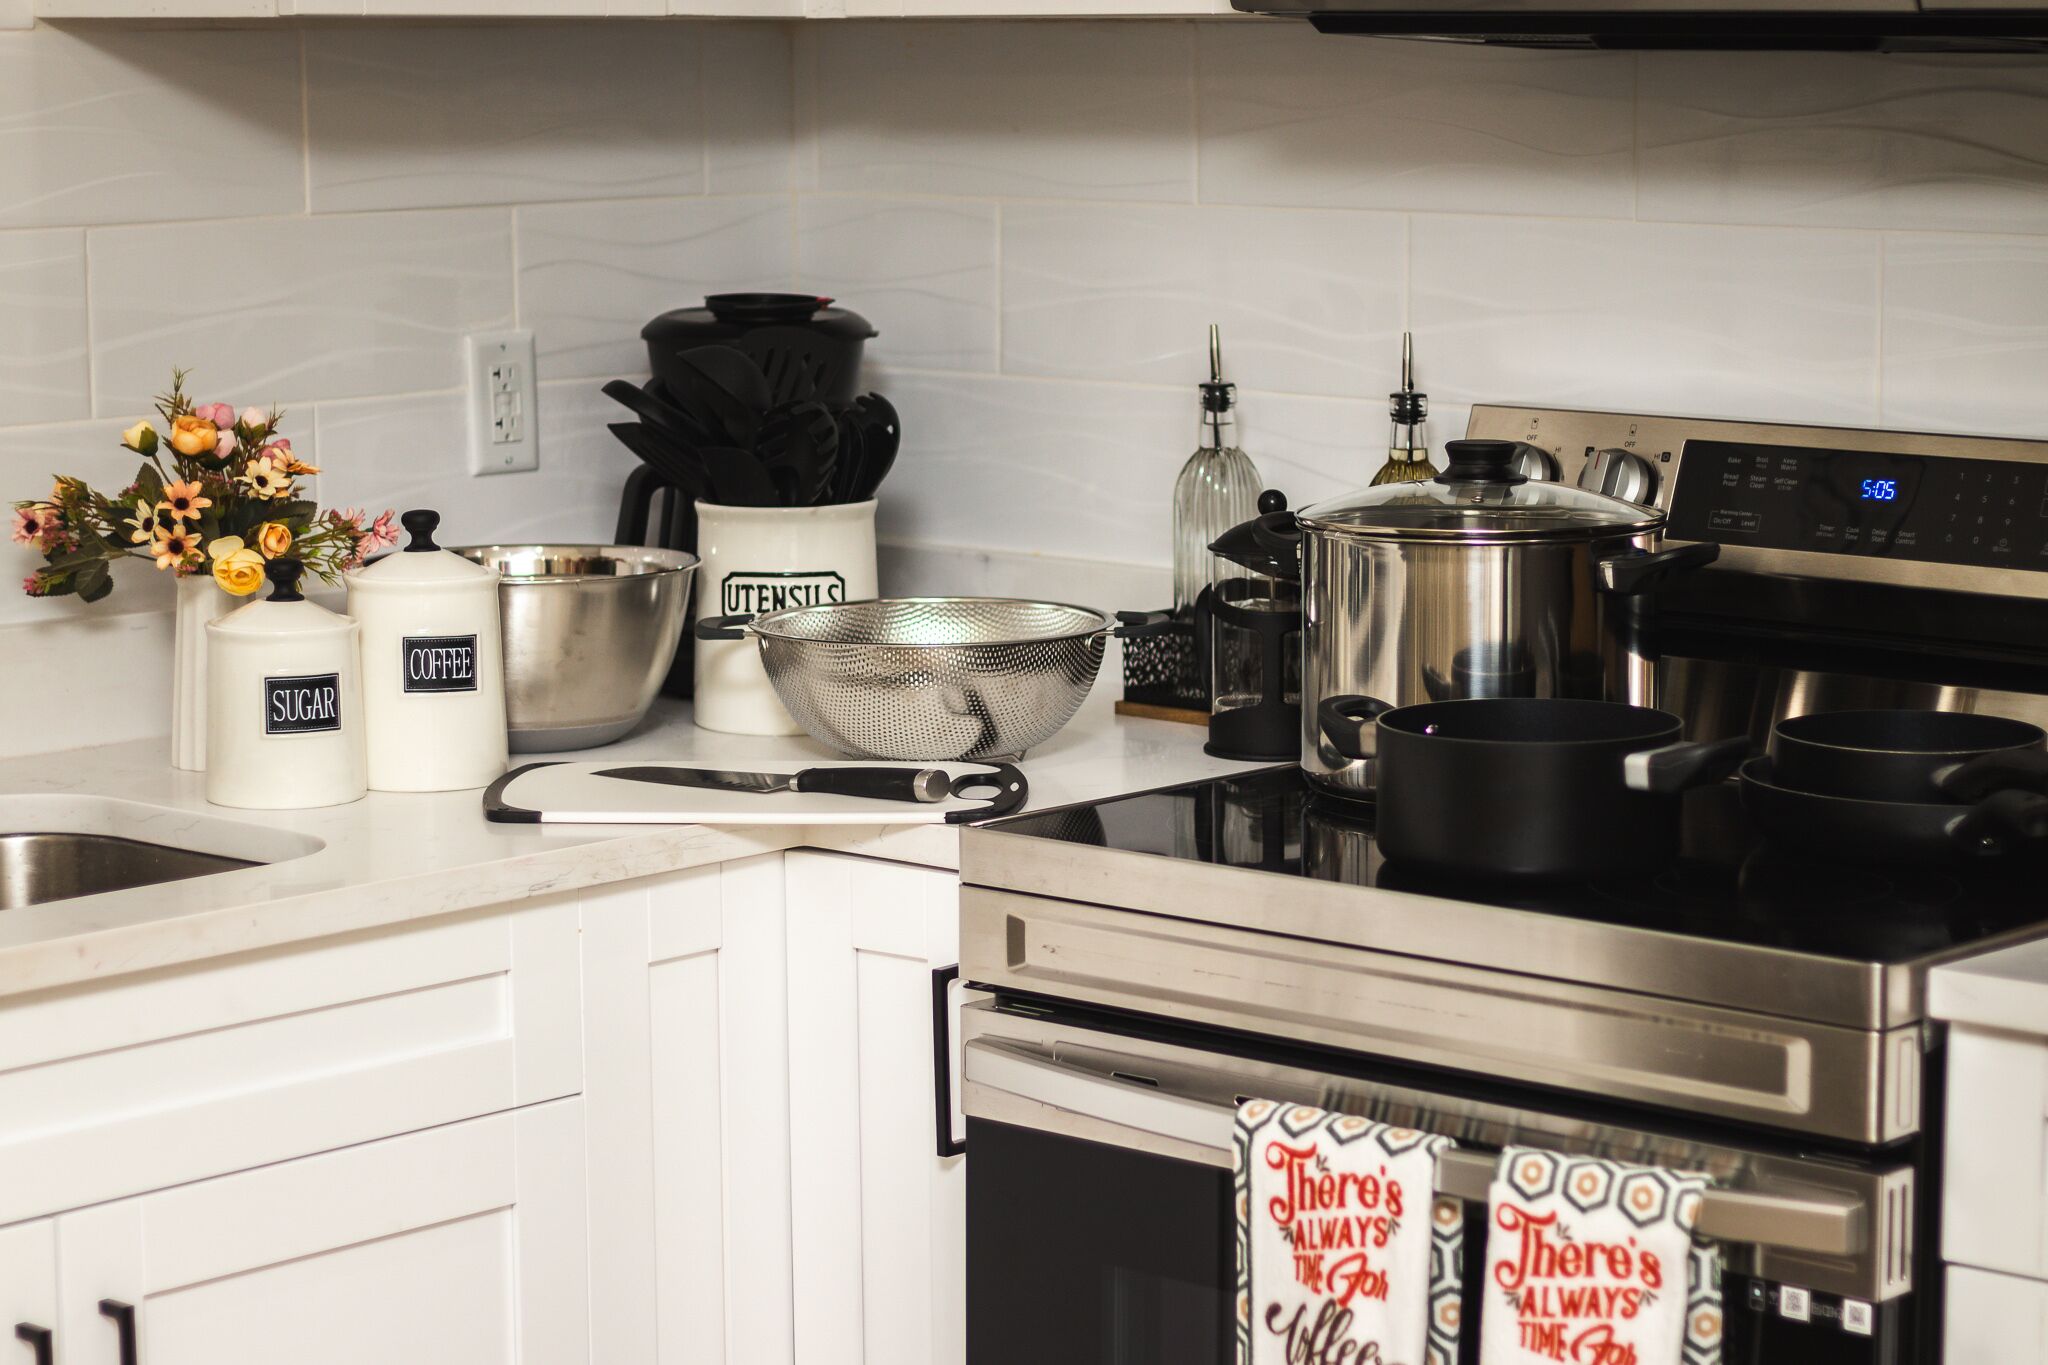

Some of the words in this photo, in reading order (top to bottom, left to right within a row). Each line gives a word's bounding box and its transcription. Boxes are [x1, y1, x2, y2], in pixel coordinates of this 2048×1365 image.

[1861, 479, 1896, 499] 5:05
[727, 583, 840, 613] UTENSILS
[410, 647, 472, 680] COFFEE
[272, 687, 336, 722] SUGAR
[1265, 1141, 1403, 1226] There's
[1293, 1216, 1389, 1251] ALWAYS
[1494, 1202, 1663, 1290] There's
[1292, 1253, 1325, 1295] TIME
[1326, 1251, 1389, 1308] For
[1519, 1286, 1641, 1320] ALWAYS
[1517, 1320, 1568, 1363] TIME
